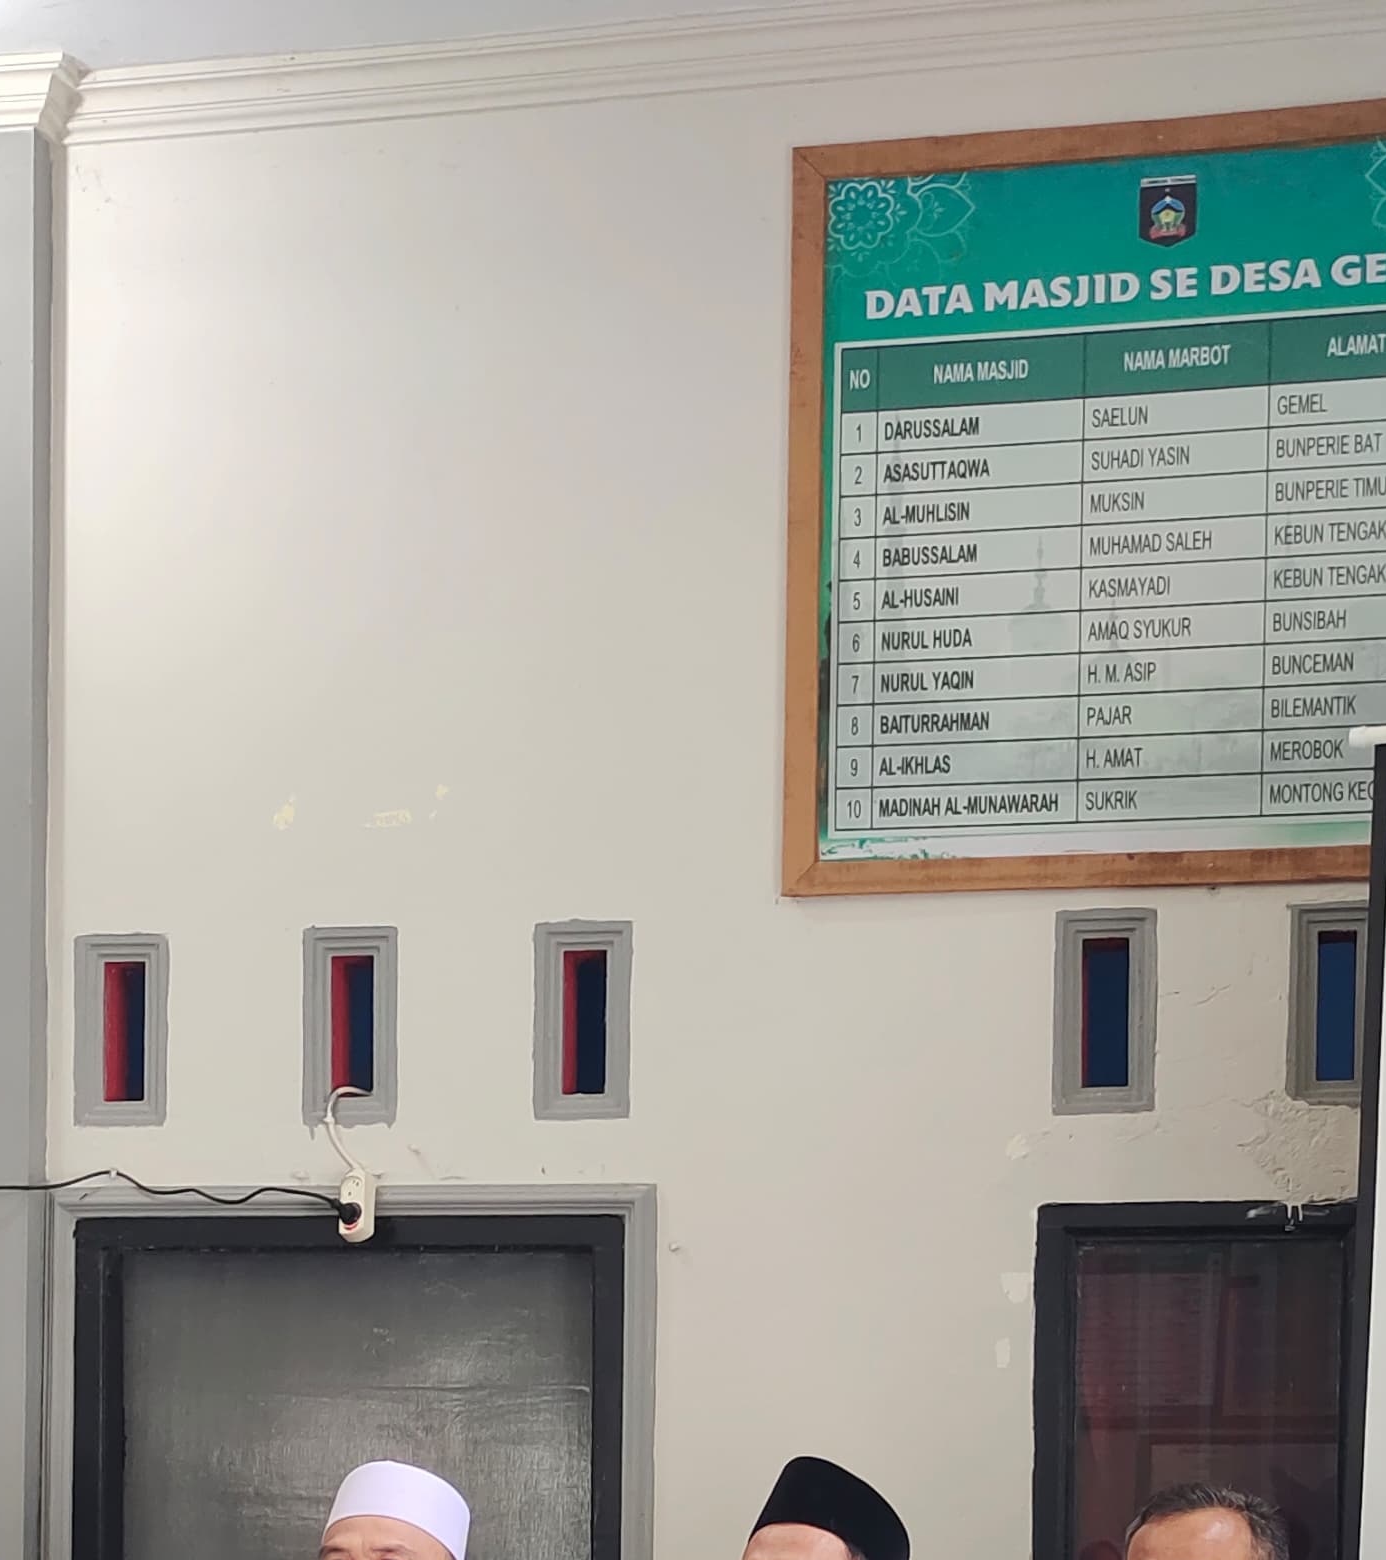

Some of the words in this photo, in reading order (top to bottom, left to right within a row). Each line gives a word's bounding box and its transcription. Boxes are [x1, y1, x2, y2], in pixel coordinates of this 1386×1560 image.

[865, 286, 972, 320] DATA
[984, 272, 1139, 310] MASJID
[1149, 268, 1196, 300] SE
[1211, 258, 1321, 295] DESA
[849, 369, 870, 390] NO
[933, 363, 973, 383] NAMA
[976, 358, 1028, 380] MASJID
[1123, 349, 1165, 370] NAMA
[1168, 344, 1231, 368] MARBOT
[1327, 333, 1386, 356] ALAMAT
[856, 425, 862, 442] 1
[884, 417, 979, 441] DARUSSALAM
[1092, 406, 1148, 427] SAELUN
[1277, 393, 1327, 415] GEMEL
[855, 466, 862, 484] 2
[884, 460, 990, 484] ASASUTTAQWA
[1092, 448, 1145, 471] SUHADI
[1148, 445, 1190, 467] YASIN
[1276, 435, 1350, 457] BUNPERIE
[1354, 433, 1383, 454] BAT
[853, 508, 862, 526] 3
[883, 502, 970, 523] AL-MUHLISIN
[1090, 492, 1145, 513] MUKSIN
[1275, 479, 1349, 501] BUNPERIE
[853, 550, 861, 568] 4
[883, 544, 977, 566] BABUSSALAM
[1090, 534, 1162, 556] MUHAMAD
[1165, 531, 1212, 552] SALEH
[1274, 523, 1323, 545] KEBUN
[1327, 520, 1386, 542] TENGAK
[853, 593, 861, 610] 5
[882, 587, 959, 608] AL-HUSAINI
[1089, 576, 1171, 598] KASMAYADI
[1273, 566, 1322, 588] KEBUN
[1326, 563, 1386, 585] TENGAK
[852, 634, 860, 651] 6
[881, 629, 928, 651] NURUL
[932, 628, 972, 648] HUDA
[1089, 620, 1128, 640] AMAQ
[1132, 617, 1192, 639] SYUKUR
[1273, 609, 1347, 631] BUNSIBAH
[851, 675, 859, 693] 7
[881, 672, 928, 693] NURUL
[931, 670, 975, 691] YAQIN
[1087, 665, 1101, 684] H.
[1105, 665, 1121, 683] M.
[1124, 662, 1157, 682] ASIP
[1272, 652, 1354, 675] BUNCEMAN
[851, 717, 859, 734] 8
[880, 711, 989, 734] BAITURRAHMAN
[1087, 705, 1132, 725] PAJAR
[1271, 695, 1356, 717] BILEMANTIK
[850, 757, 858, 775] 9
[880, 754, 950, 775] AL-IKHLAS
[1086, 749, 1101, 768] H.
[1105, 747, 1142, 768] AMAT
[1270, 740, 1344, 761] MEROBOK
[845, 799, 862, 818] 10
[879, 795, 941, 817] MADINAH
[944, 792, 1059, 815] AL-MUNAWARAH
[1086, 790, 1138, 810] SUKRIK
[1270, 782, 1344, 804] MONTONG
